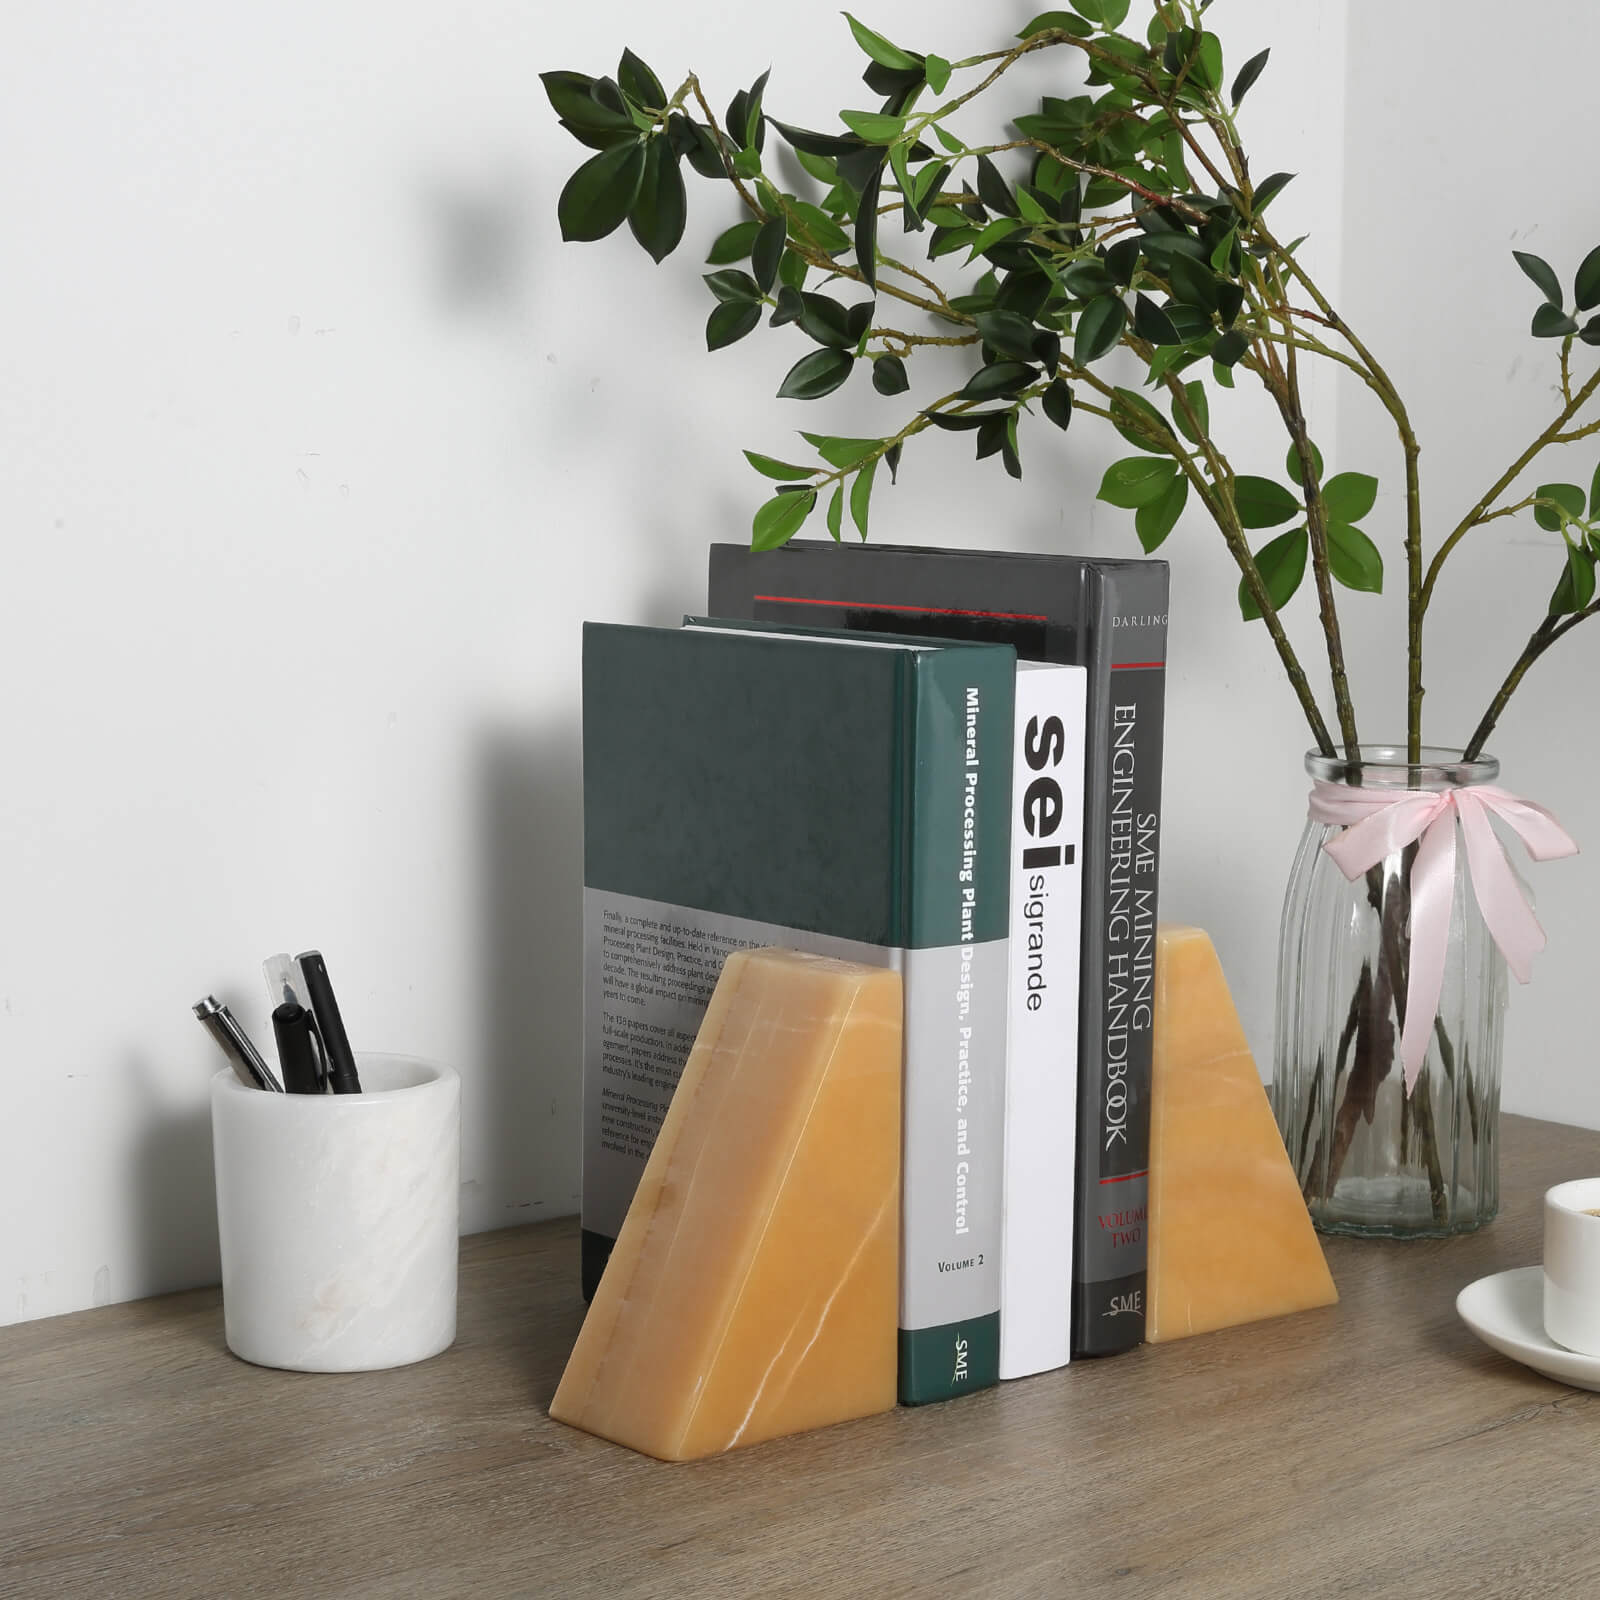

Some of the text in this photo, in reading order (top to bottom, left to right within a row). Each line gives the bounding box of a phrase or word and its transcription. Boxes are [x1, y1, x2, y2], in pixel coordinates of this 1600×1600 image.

[1112, 614, 1168, 627] DARLING
[1022, 714, 1075, 1011] sei sigrande
[630, 917, 658, 929] complete
[660, 922, 671, 932] and
[672, 926, 706, 940] up-to-date
[707, 932, 737, 945] reference
[1105, 703, 1136, 1151] ENGINEERING HANDBOOK
[1131, 813, 1157, 1031] SME MINING
[603, 925, 626, 935] mineral
[627, 930, 658, 945] processing
[688, 941, 702, 952] Held
[603, 936, 634, 953] Processing
[636, 943, 651, 954] Plant
[705, 959, 717, 969] and
[955, 687, 979, 1235] Mineral Processing Plant Design, Practice, and Control
[611, 952, 660, 972] comprehensively
[662, 963, 686, 976] address
[687, 968, 704, 980] plant
[603, 976, 613, 985] will
[656, 988, 676, 1000] impact
[628, 968, 639, 978] The
[641, 972, 666, 986] resulting
[668, 978, 705, 993] proceedings
[603, 990, 618, 1000] years
[620, 992, 625, 1001] to
[603, 1011, 615, 1022] The
[628, 1019, 648, 1031] papers
[632, 1047, 652, 1059] papers
[653, 1053, 677, 1065] address
[644, 1062, 655, 1072] the
[626, 1094, 658, 1112] Processing
[1112, 1229, 1141, 1249] TWO
[978, 1254, 984, 1266] 2
[1110, 1290, 1141, 1314] SME
[955, 1339, 968, 1380] SME
